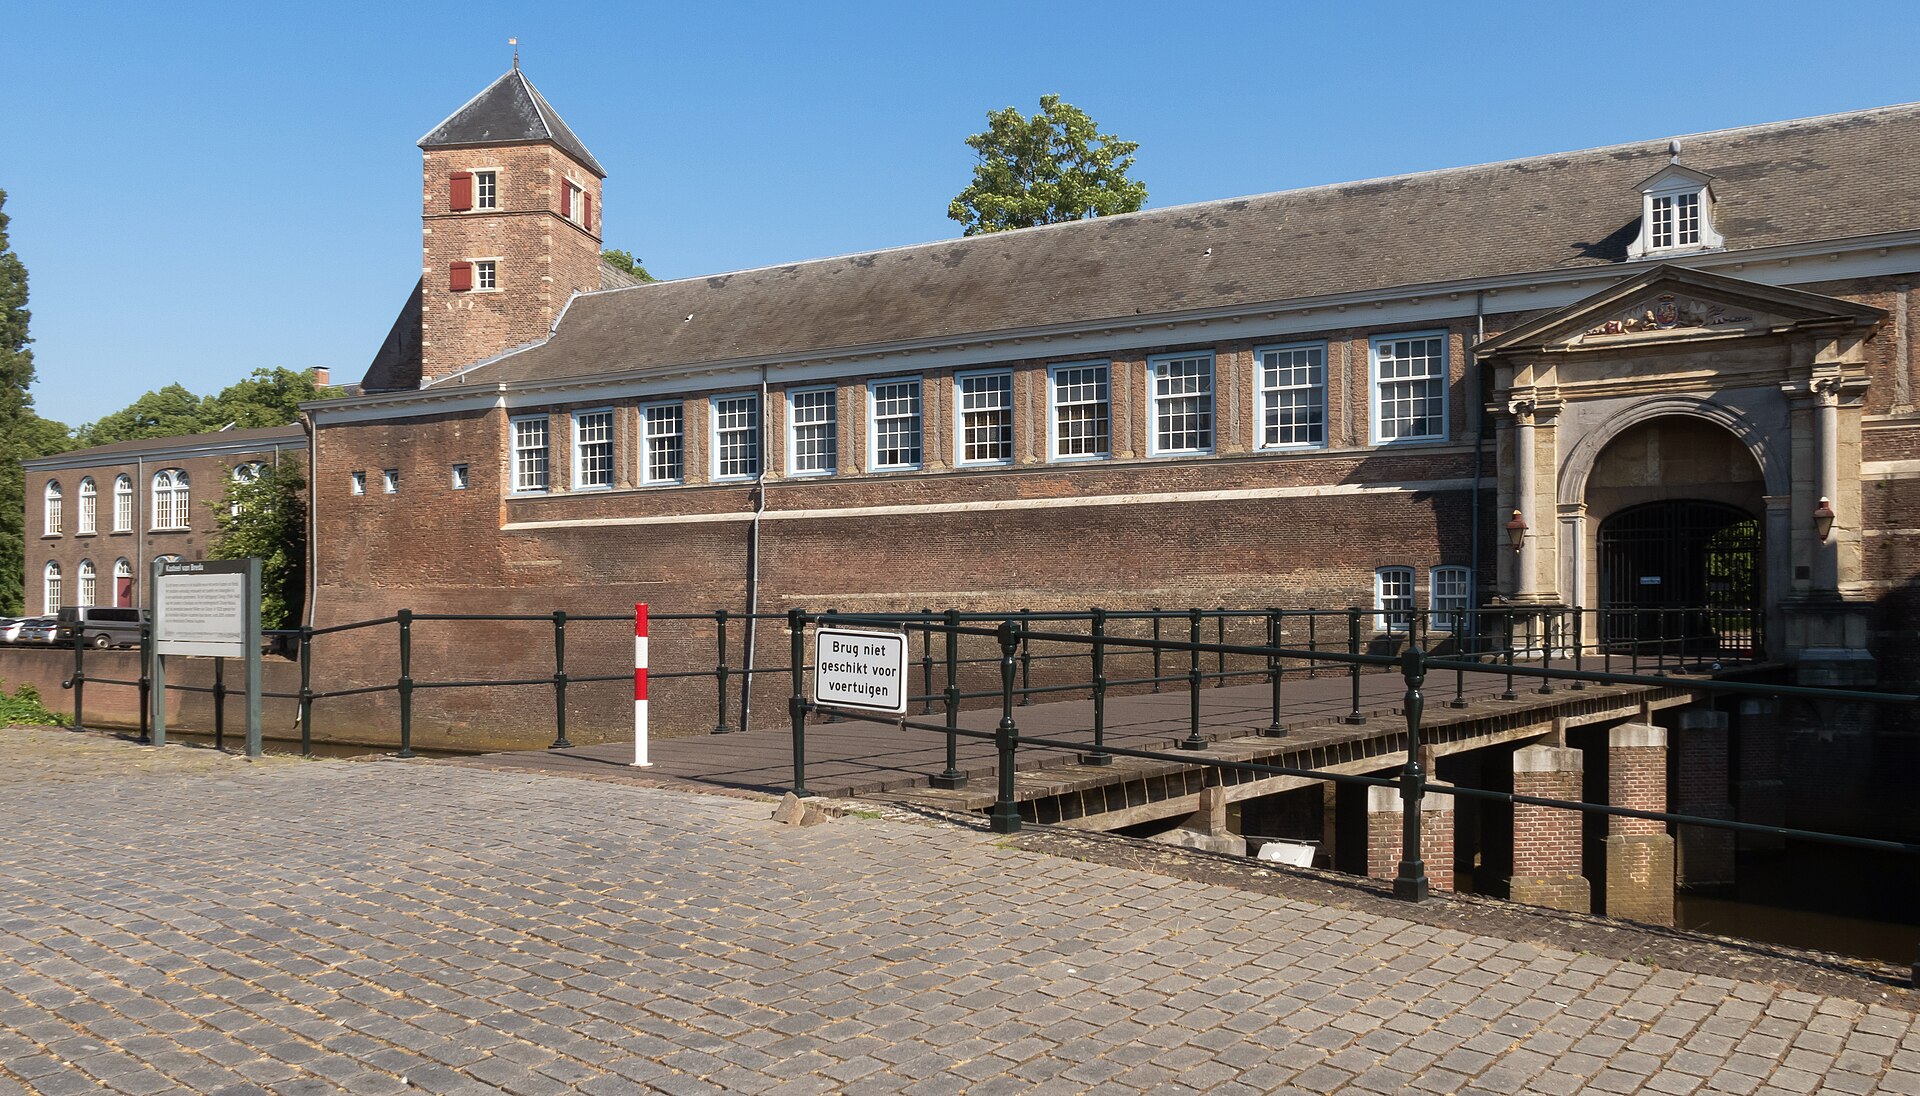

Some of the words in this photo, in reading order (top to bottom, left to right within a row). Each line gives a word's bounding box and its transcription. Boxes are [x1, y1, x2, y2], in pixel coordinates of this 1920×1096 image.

[832, 641, 859, 658] Brug
[864, 644, 886, 657] niet
[821, 661, 868, 675] geschikt
[872, 666, 897, 677] voor
[829, 681, 888, 698] voertuigen
